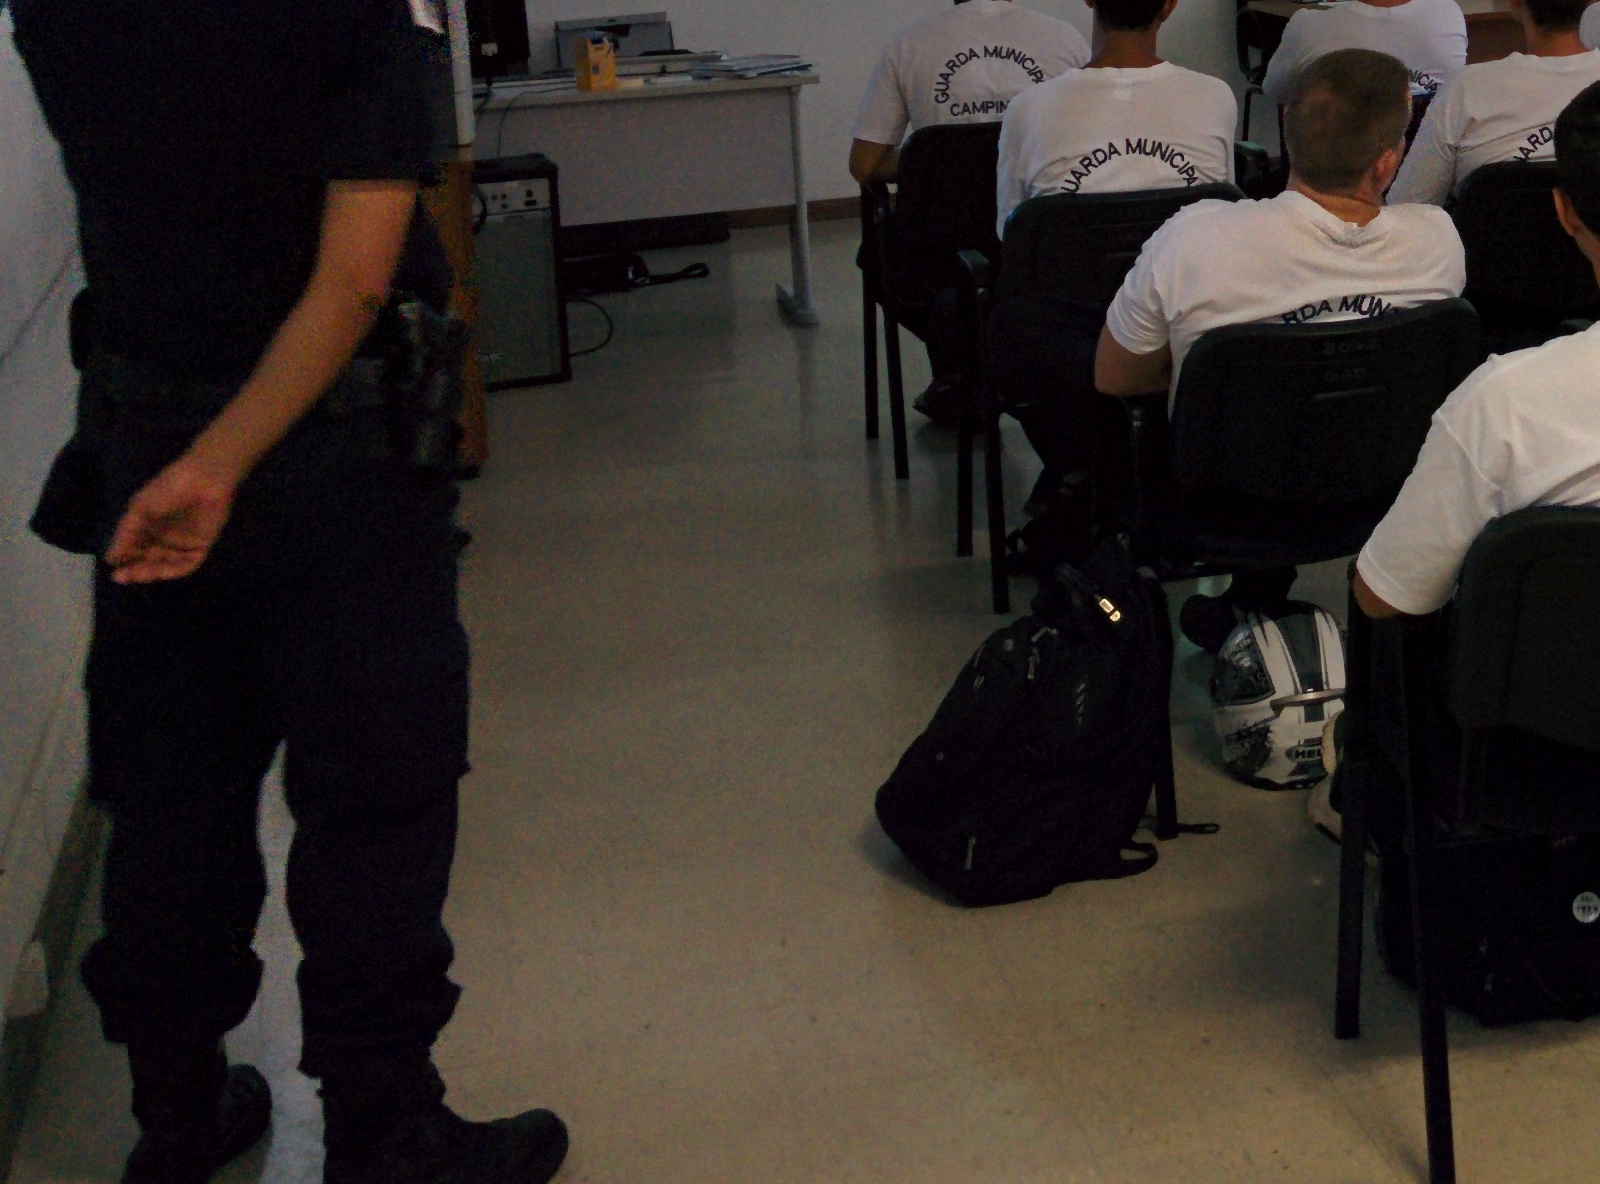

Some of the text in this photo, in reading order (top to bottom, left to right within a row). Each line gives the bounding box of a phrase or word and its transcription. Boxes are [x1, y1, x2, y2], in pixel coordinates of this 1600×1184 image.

[934, 45, 1045, 104] GUARDA MUNICIPA
[950, 98, 1011, 116] CAMPIN
[1513, 127, 1553, 160] ARD
[1061, 137, 1199, 194] UARDA MUNICIPA
[1281, 294, 1391, 324] RDA MUN
[1295, 748, 1322, 760] HEL
